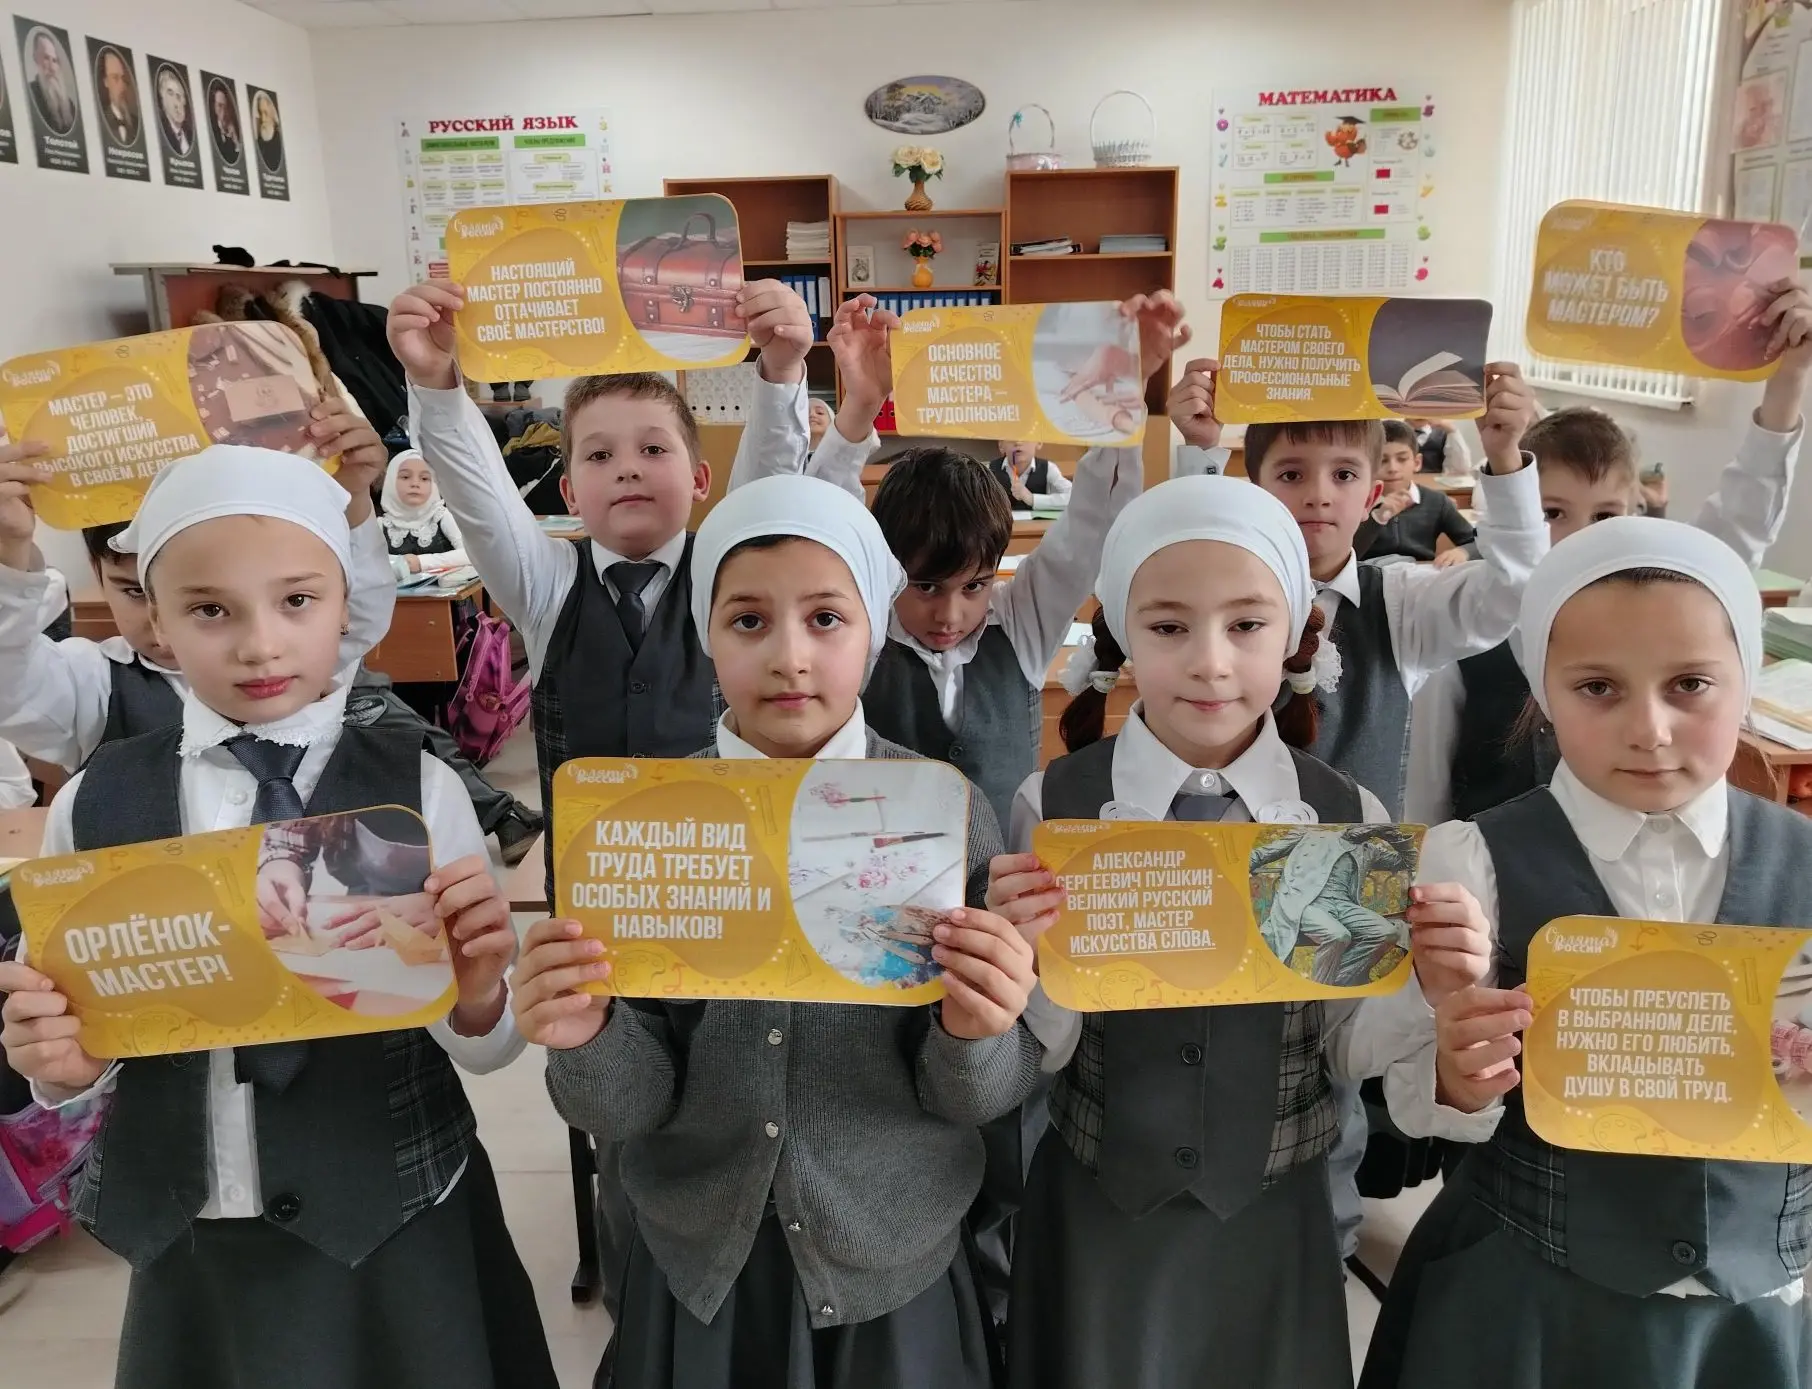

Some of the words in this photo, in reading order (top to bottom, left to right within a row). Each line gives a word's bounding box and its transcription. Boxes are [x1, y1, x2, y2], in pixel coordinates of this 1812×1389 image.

[1258, 88, 1397, 106] МАТЕМАТИКА
[428, 115, 514, 134] РУССКИЙ
[522, 116, 578, 130] ЯЗЫК
[490, 257, 576, 280] НАСТОЯЩИЙ
[1590, 249, 1626, 272] КТО
[467, 284, 521, 302] МАСТЕР
[524, 278, 602, 299] ПОСТОЯННО
[1544, 271, 1612, 298] МОЖЕТ
[1616, 276, 1668, 303] БЫТЬ
[494, 299, 579, 321] ОТТАЧИВАЕТ
[1547, 298, 1660, 328] МАСТЕРОМ?
[477, 321, 513, 342] СВОЁ
[515, 317, 605, 340] МАСТЕРСТВО!
[1256, 323, 1295, 339] ЧТОБЫ
[1297, 324, 1332, 339] СТАТЬ
[928, 342, 1002, 362] ОСНОВНОЕ
[1240, 340, 1300, 355] МАСТЕРОМ
[1303, 340, 1345, 356] СВОЕГО
[930, 364, 1002, 384] КАЧЕСТВО
[1259, 355, 1299, 370] НУЖНО
[1301, 356, 1361, 372] ПОЛУЧИТЬ
[1230, 370, 1351, 387] ПРОФЕССИОНАЛЬНЫЕ
[48, 391, 108, 417] МАСТЕР
[124, 383, 154, 402] ЭТО
[927, 385, 993, 404] МАСТЕРА
[1266, 387, 1314, 401] ЗНАНИЯ.
[916, 404, 1020, 425] ТРУДОЛЮБИЕ!
[67, 418, 158, 455] ДОСТИГШИЙ
[116, 433, 201, 464] ИСКУССТВА
[71, 472, 82, 488] В
[84, 464, 134, 486] СВОЁМ
[136, 457, 172, 479] ДЕЛ
[595, 817, 697, 850] КАЖДЫЙ
[701, 823, 746, 852] ВИД
[587, 852, 659, 881] ТРУДА
[662, 854, 754, 882] ТРЕБУЕТ
[1093, 850, 1186, 870] АЛЕКСАНДР
[1055, 872, 1141, 891] СЕРГЕЕВИЧ
[1145, 868, 1213, 888] ПУШКИН
[571, 884, 661, 910] ОСОБЫХ
[666, 881, 752, 911] ЗНАНИЙ
[757, 886, 771, 912] И
[1067, 888, 1139, 911] ВЕЛИКИЙ
[1143, 886, 1213, 908] РУССКИЙ
[613, 914, 723, 940] НАВЫКОВ!
[1087, 913, 1130, 931] ПОЭТ,
[1134, 910, 1194, 929] МАСТЕР
[64, 911, 232, 965] ОРЛЁНОК-
[1070, 931, 1158, 954] ИСКУССТВА
[1160, 929, 1216, 949] СЛОВА.
[88, 952, 234, 998] МАСТЕР!
[1570, 988, 1628, 1007] ЧТОБЫ
[1633, 990, 1731, 1011] ПРЕУСПЕТЬ
[1558, 1009, 1569, 1028] В
[1573, 1010, 1682, 1032] ВЫБРАННОМ
[1686, 1013, 1737, 1035] ДЕЛЕ,
[1557, 1031, 1618, 1051] НУЖНО
[1622, 1033, 1654, 1052] ЕГО
[1658, 1034, 1735, 1057] ЛЮБИТЬ,
[1587, 1054, 1705, 1077] ВКЛАДЫВАТЬ
[1564, 1076, 1614, 1098] ДУШУ
[1619, 1078, 1630, 1097] В
[1634, 1075, 1678, 1099] СВОЙ
[1683, 1080, 1733, 1104] ТРУД.
